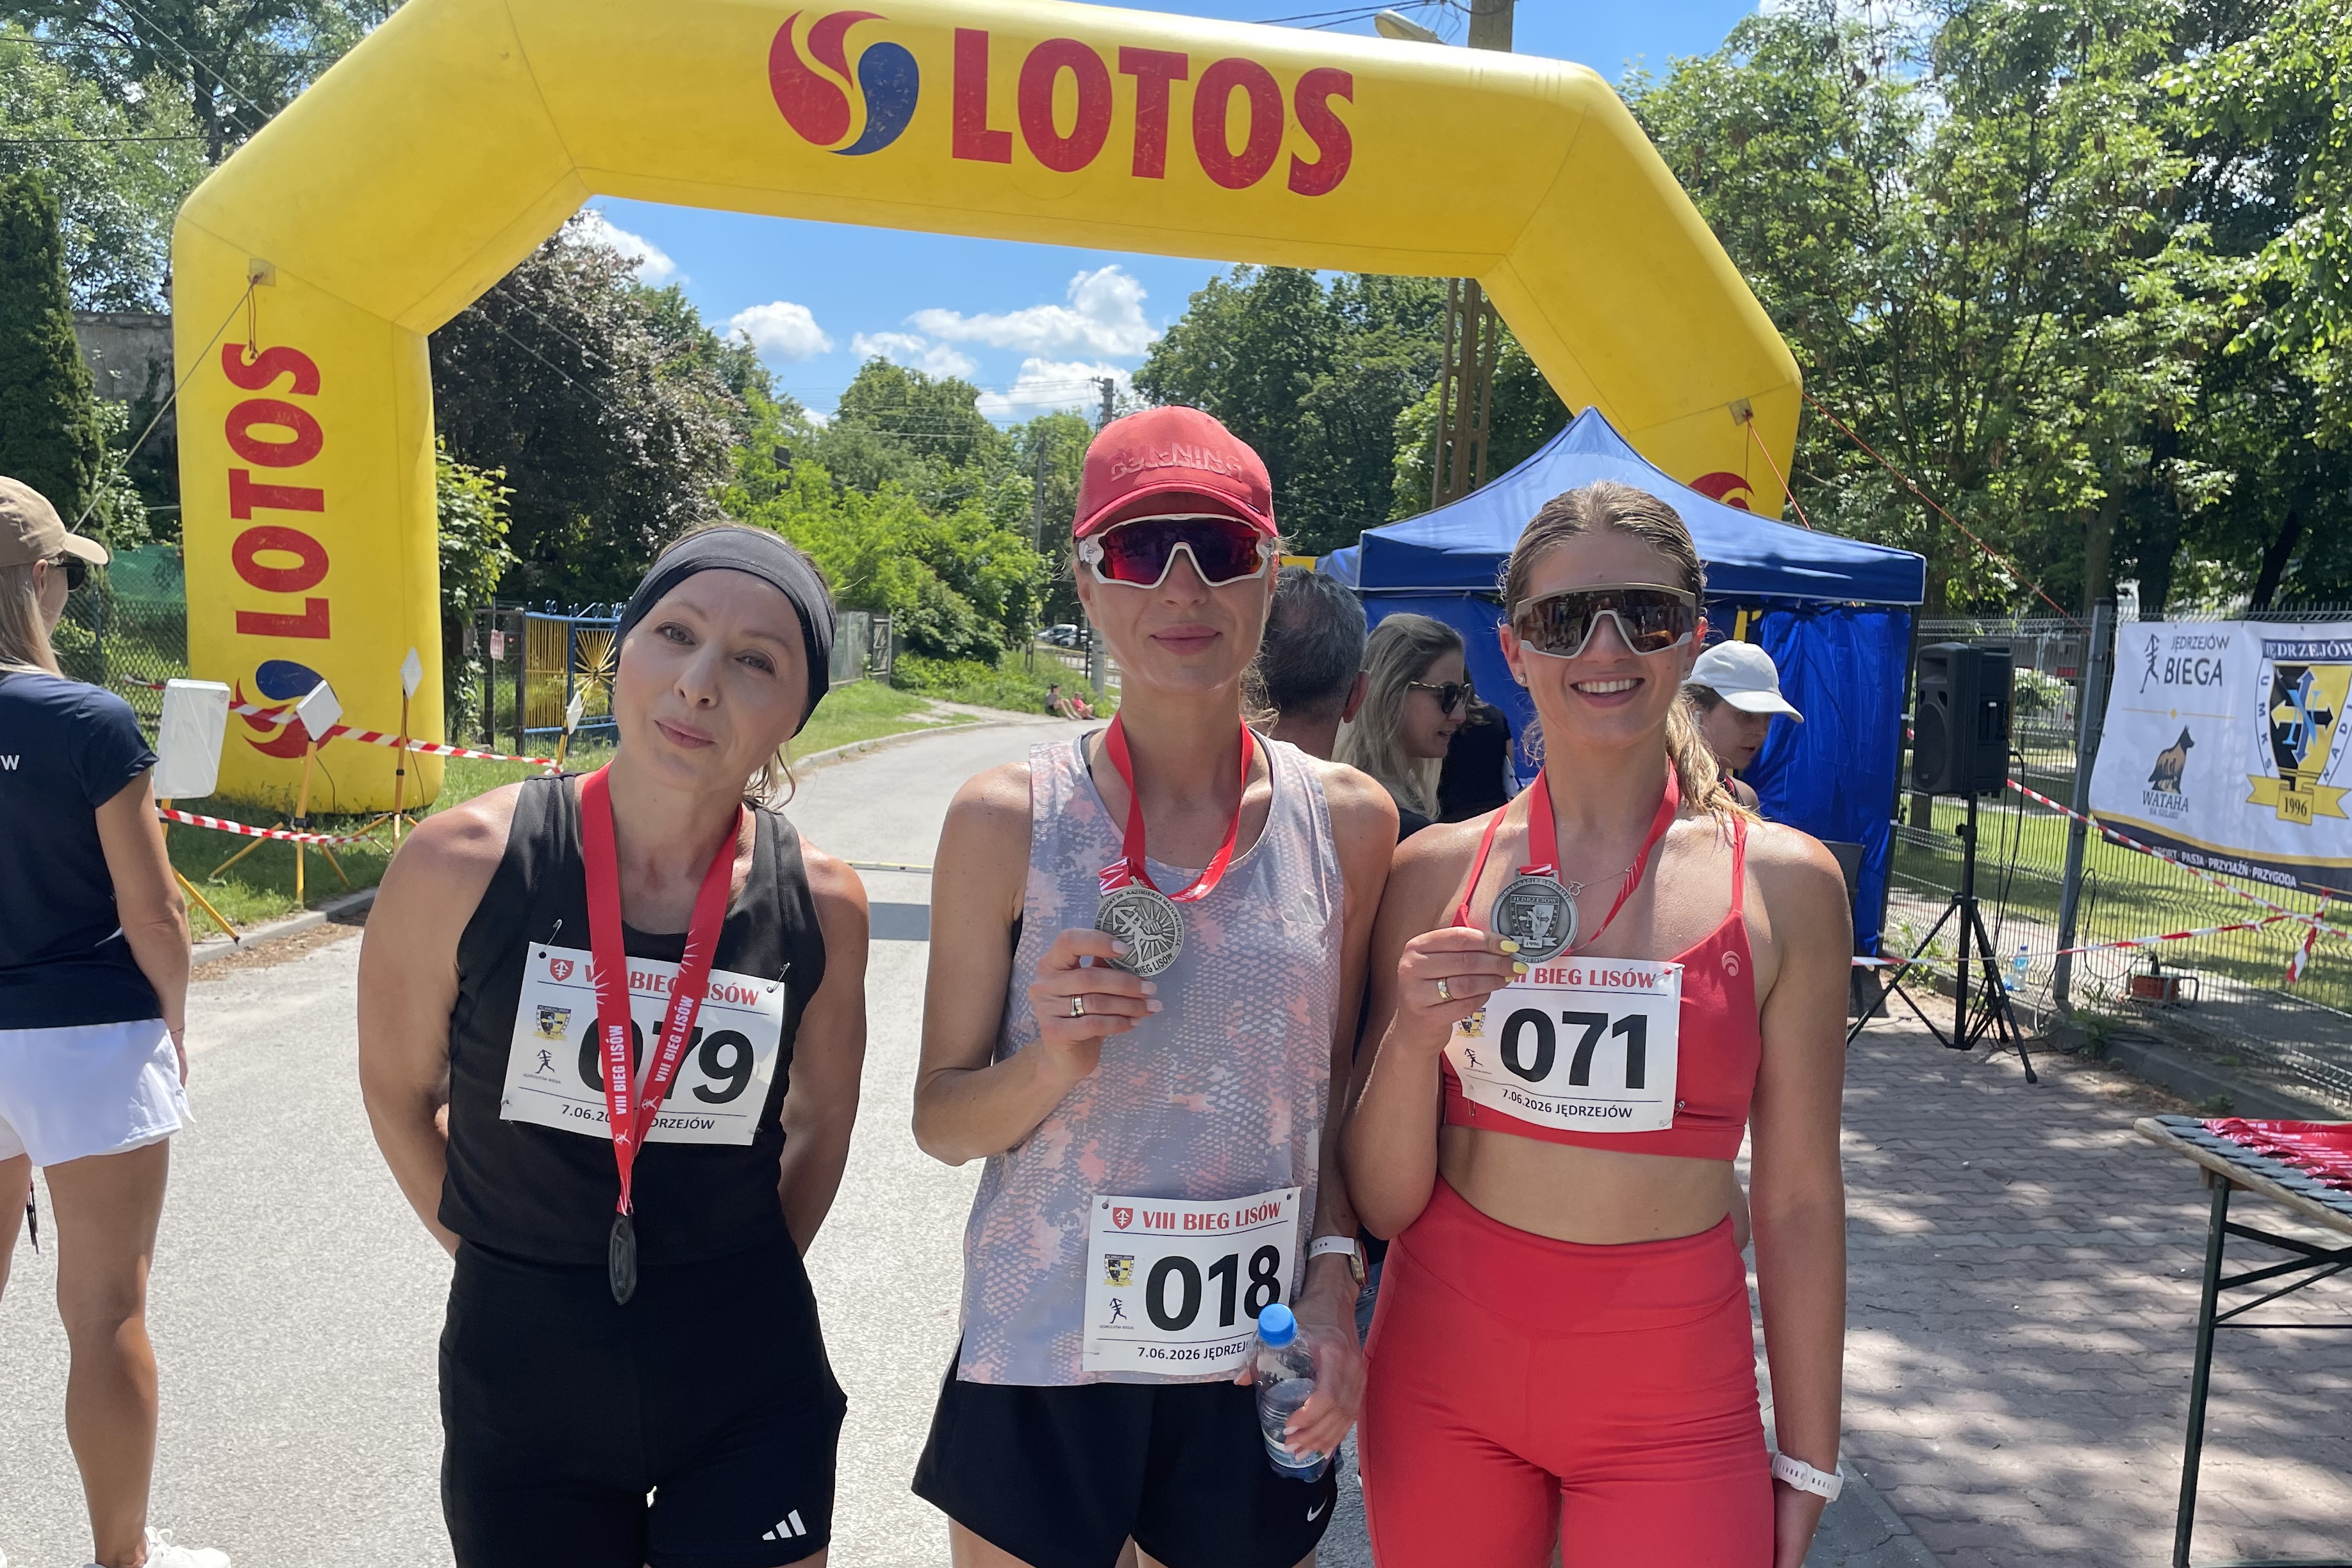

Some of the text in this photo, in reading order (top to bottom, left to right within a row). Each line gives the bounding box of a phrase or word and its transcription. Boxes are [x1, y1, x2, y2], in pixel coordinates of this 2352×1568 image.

[952, 28, 1354, 197] LOTOS
[221, 343, 331, 640] LOTOS
[2171, 632, 2230, 653] JĘDRZEJÓW
[2164, 657, 2222, 687] BIEGA
[0, 755, 20, 770] W
[2143, 790, 2189, 813] WATAHA
[2284, 796, 2307, 817] 1996
[2182, 851, 2205, 867] PASJA
[2253, 866, 2297, 888] PRZYGODA
[1143, 921, 1161, 934] VIII
[1534, 968, 1582, 985] BIEG
[1589, 968, 1657, 989] LISÓW
[702, 982, 759, 1006] ISÓW
[654, 994, 695, 1082] VIII BIEG LISÓW
[1500, 1008, 1648, 1089] 071
[578, 1017, 754, 1104] 079
[605, 1025, 627, 1116] VIII BIEG LISÓW
[1502, 1088, 1633, 1118] 7.06.2026 JĘDRZEJÓW
[650, 1116, 715, 1130] DRZEJÓW
[1143, 1200, 1281, 1230] VIII BIEG LISÓW
[1146, 1244, 1280, 1332] 018
[1138, 1341, 1249, 1360] 7.06.2026 JĘDRZEJ
